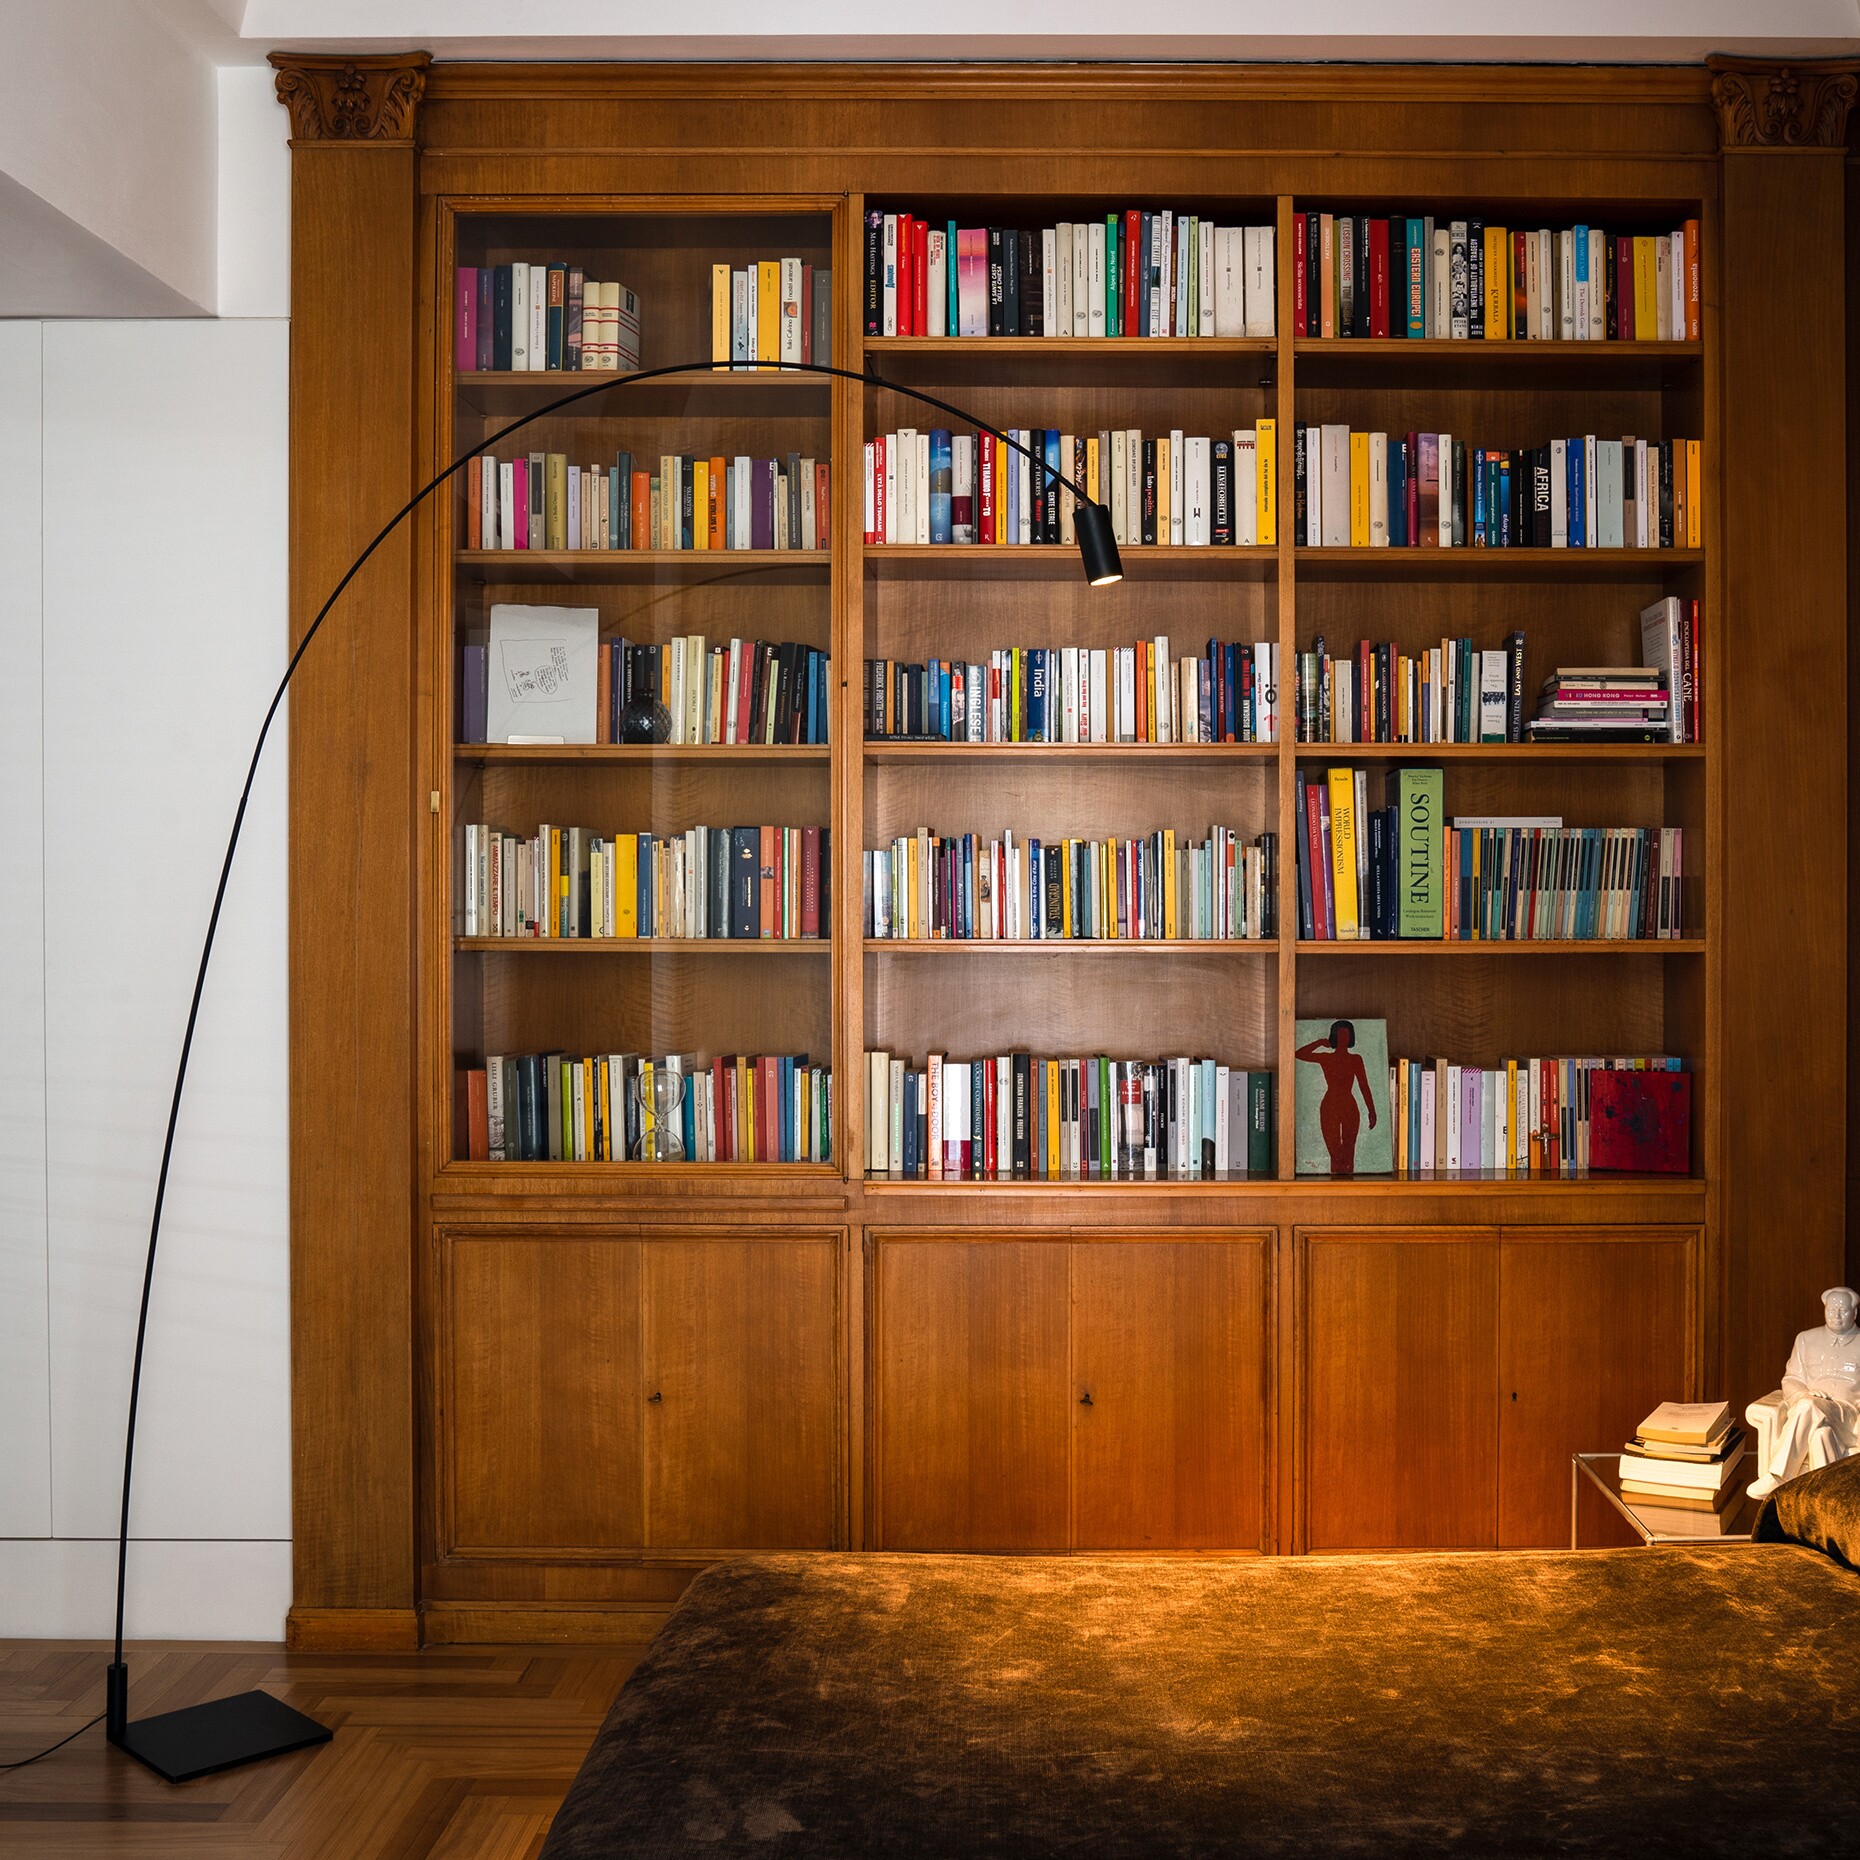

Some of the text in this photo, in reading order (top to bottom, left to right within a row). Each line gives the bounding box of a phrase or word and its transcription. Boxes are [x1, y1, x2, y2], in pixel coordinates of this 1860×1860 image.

[1152, 245, 1160, 264] COMPANY
[1343, 286, 1351, 299] TOM
[1411, 248, 1421, 317] EASTERN EUROPE!
[1491, 289, 1499, 323] KERBALA
[1218, 490, 1226, 515] LIBRO
[1537, 467, 1549, 511] AFRICA
[1218, 515, 1225, 524] IL
[876, 662, 884, 710] FREDERICK FORSYTH
[1033, 668, 1045, 697] India
[1682, 672, 1692, 702] CANE
[970, 687, 981, 732] INGLESE
[1343, 808, 1351, 839] WORLD
[1334, 808, 1344, 874] IMPRESSIONISM
[1410, 793, 1430, 904] SOUTINE
[1048, 883, 1061, 919] STALINGRAD
[931, 1061, 939, 1079] THE
[931, 1083, 939, 1102] BOY
[931, 1111, 939, 1140] DOOR
